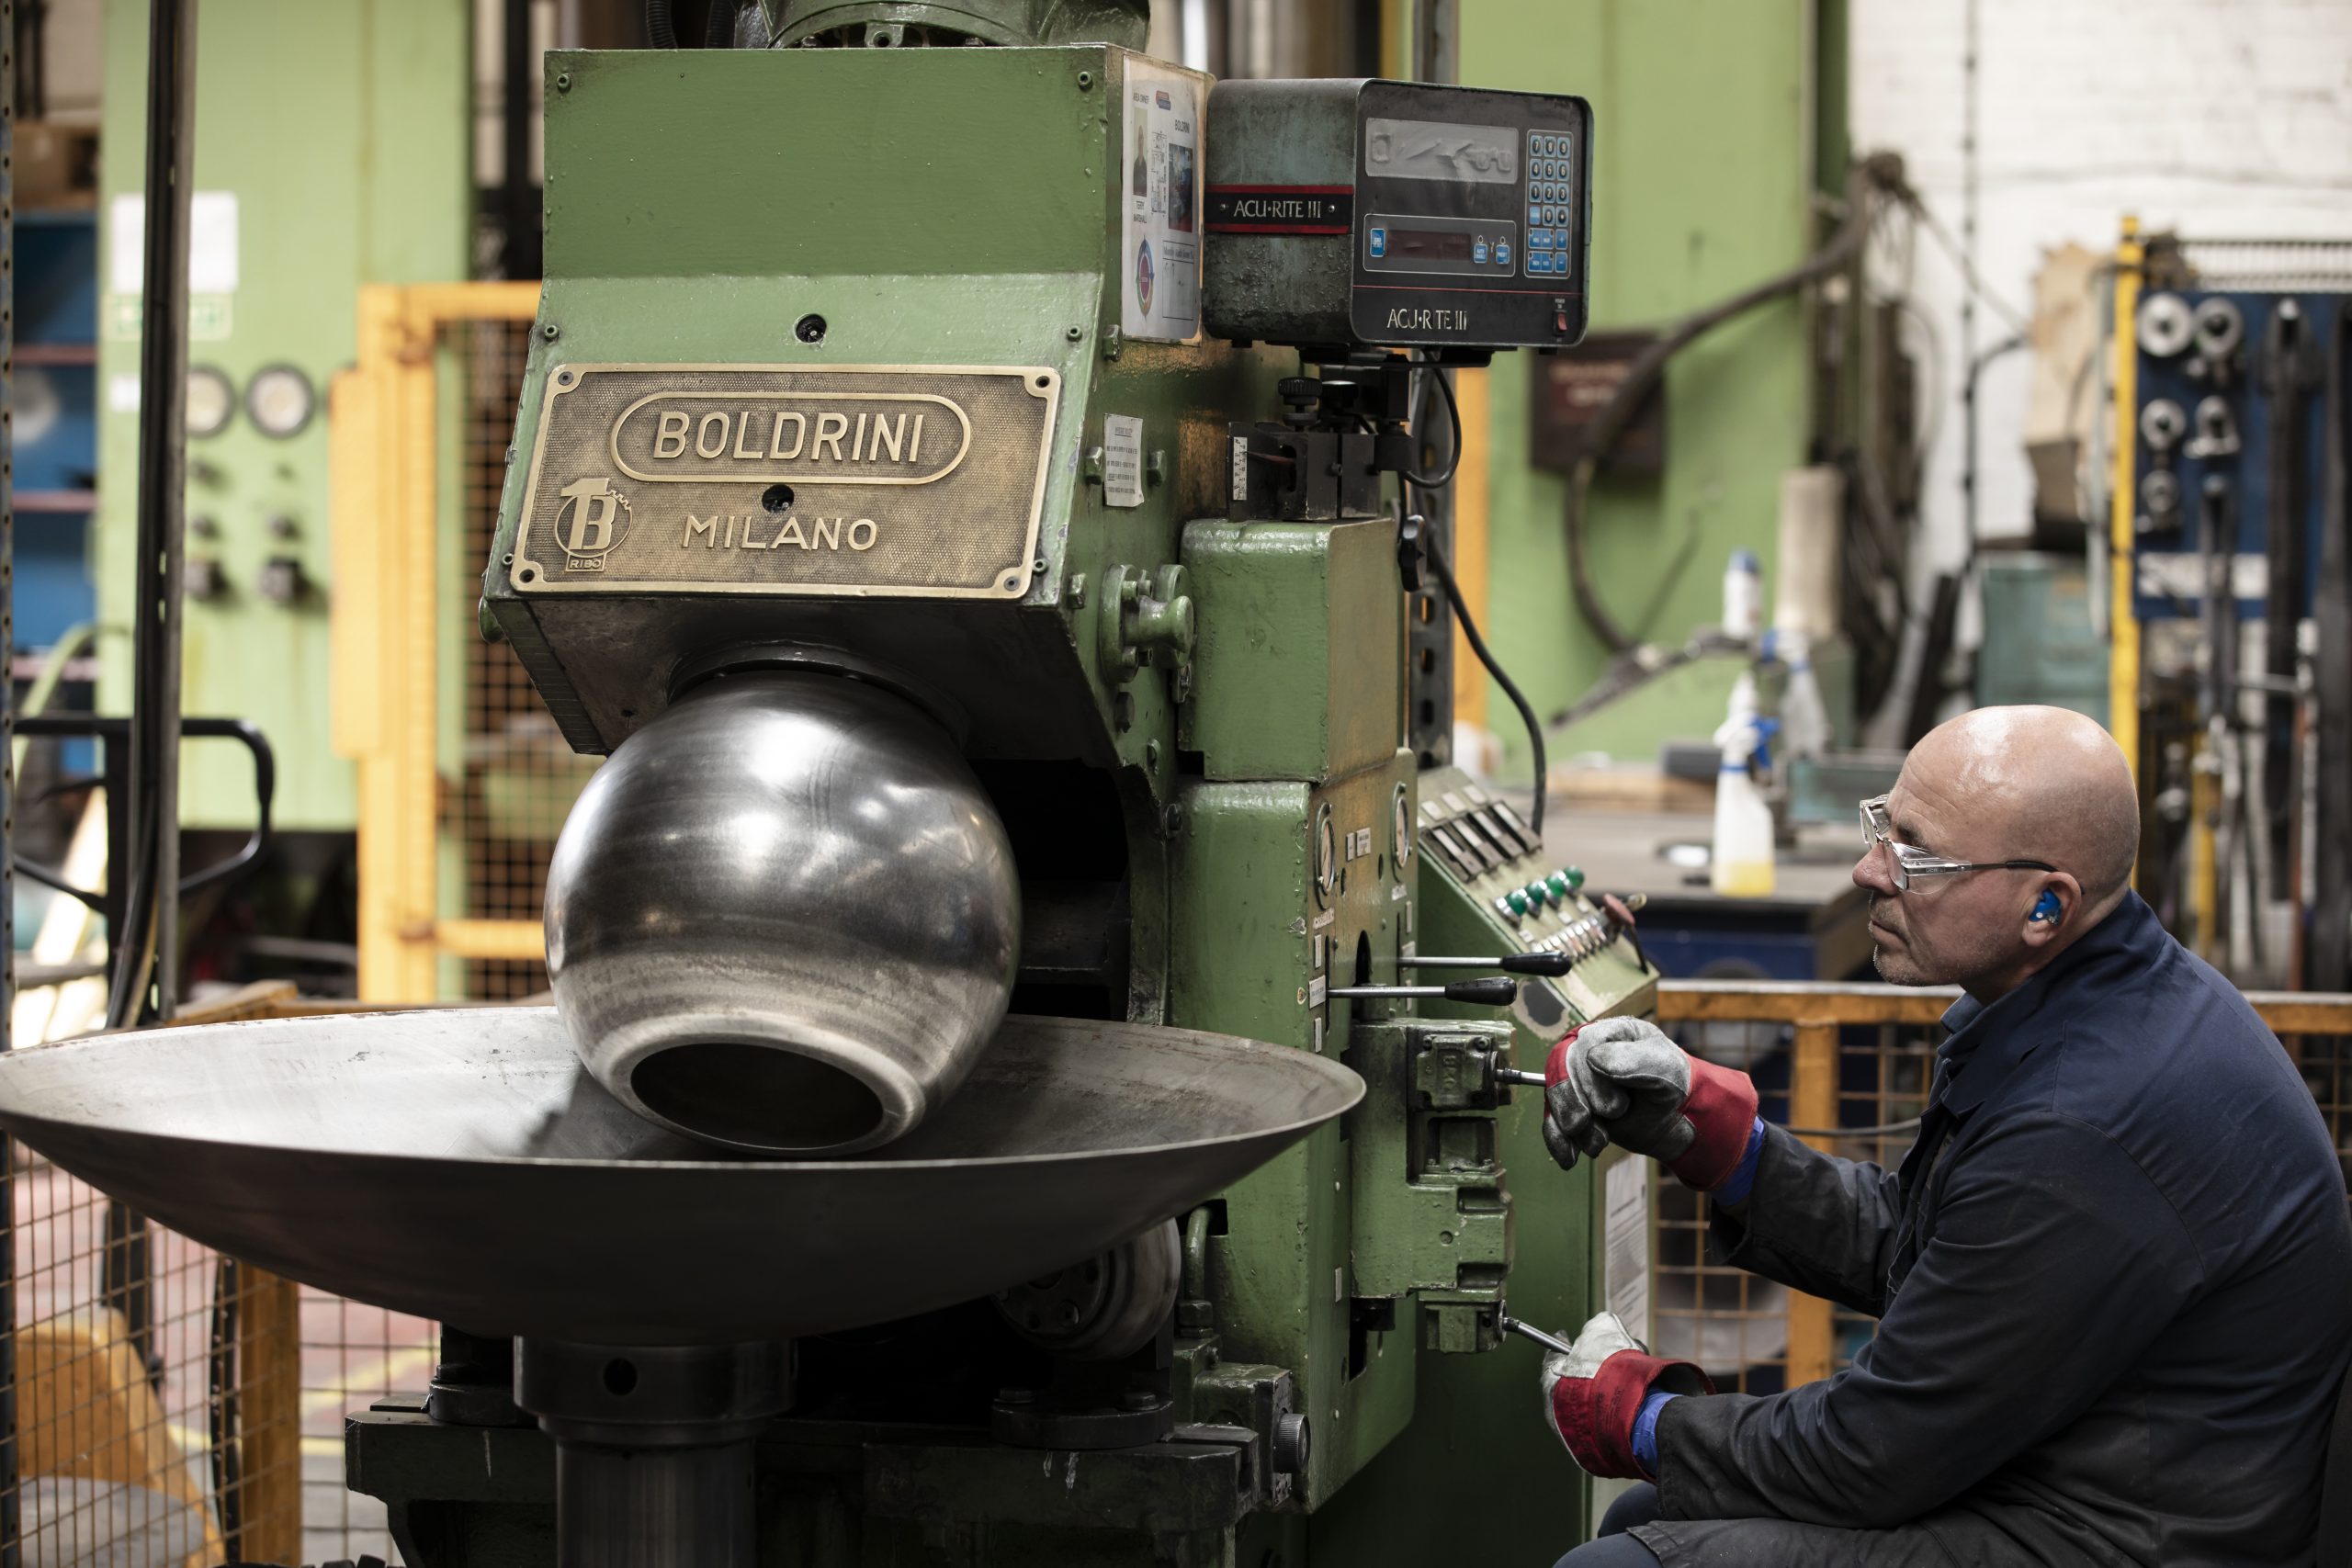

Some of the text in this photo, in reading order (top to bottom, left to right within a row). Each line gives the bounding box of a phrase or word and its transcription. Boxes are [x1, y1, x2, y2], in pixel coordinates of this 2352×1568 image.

[1307, 200, 1321, 219] III
[653, 411, 924, 462] BOLDRINI
[682, 515, 879, 551] MILANO
